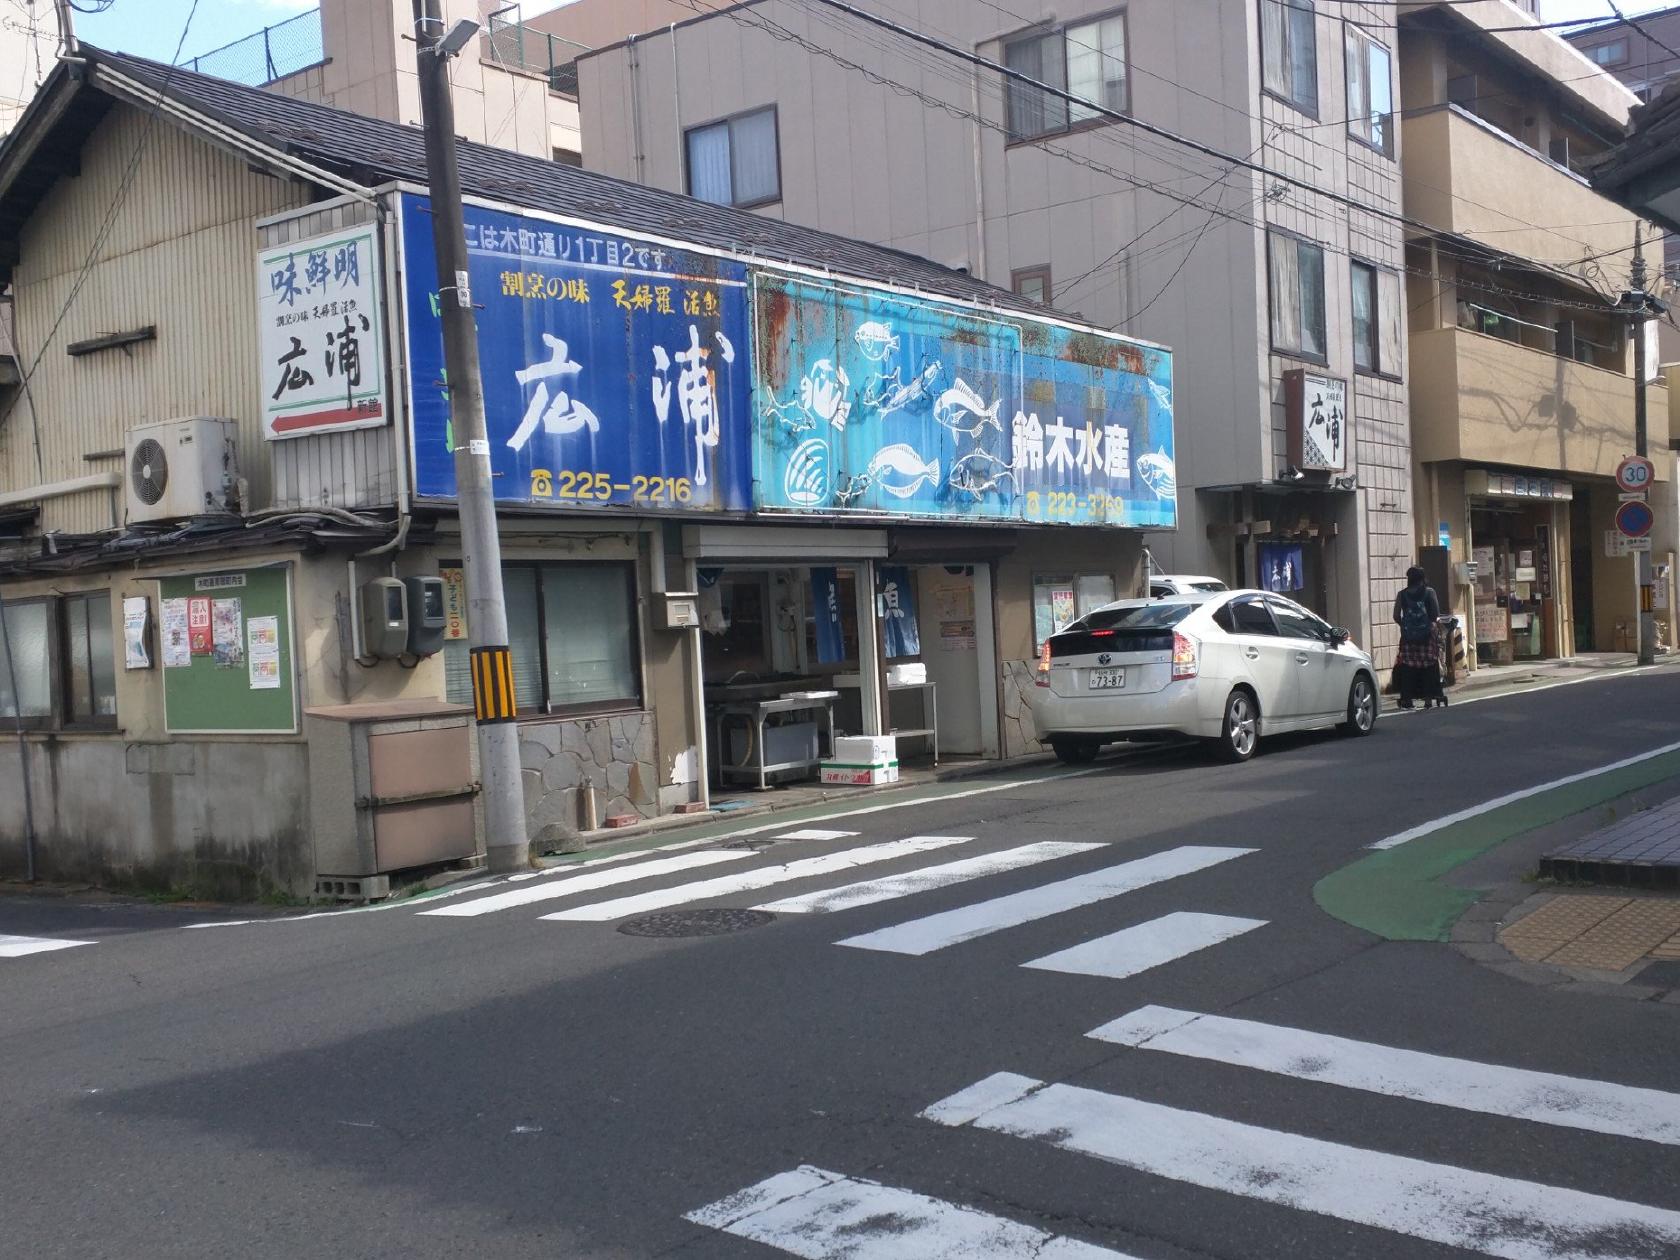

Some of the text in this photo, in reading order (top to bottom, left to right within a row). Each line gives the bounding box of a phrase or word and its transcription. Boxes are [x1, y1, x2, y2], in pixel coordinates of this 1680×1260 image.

[270, 241, 360, 307] 味鮮明
[500, 270, 590, 304] 割烹の味
[611, 279, 676, 315] 天婦羅
[271, 314, 370, 411] 広浦
[506, 324, 736, 486] 広浦
[1308, 392, 1343, 462] 広浦
[1011, 410, 1131, 479] 鈴木水産
[1625, 466, 1646, 483] 30
[558, 470, 691, 502] 225-2216
